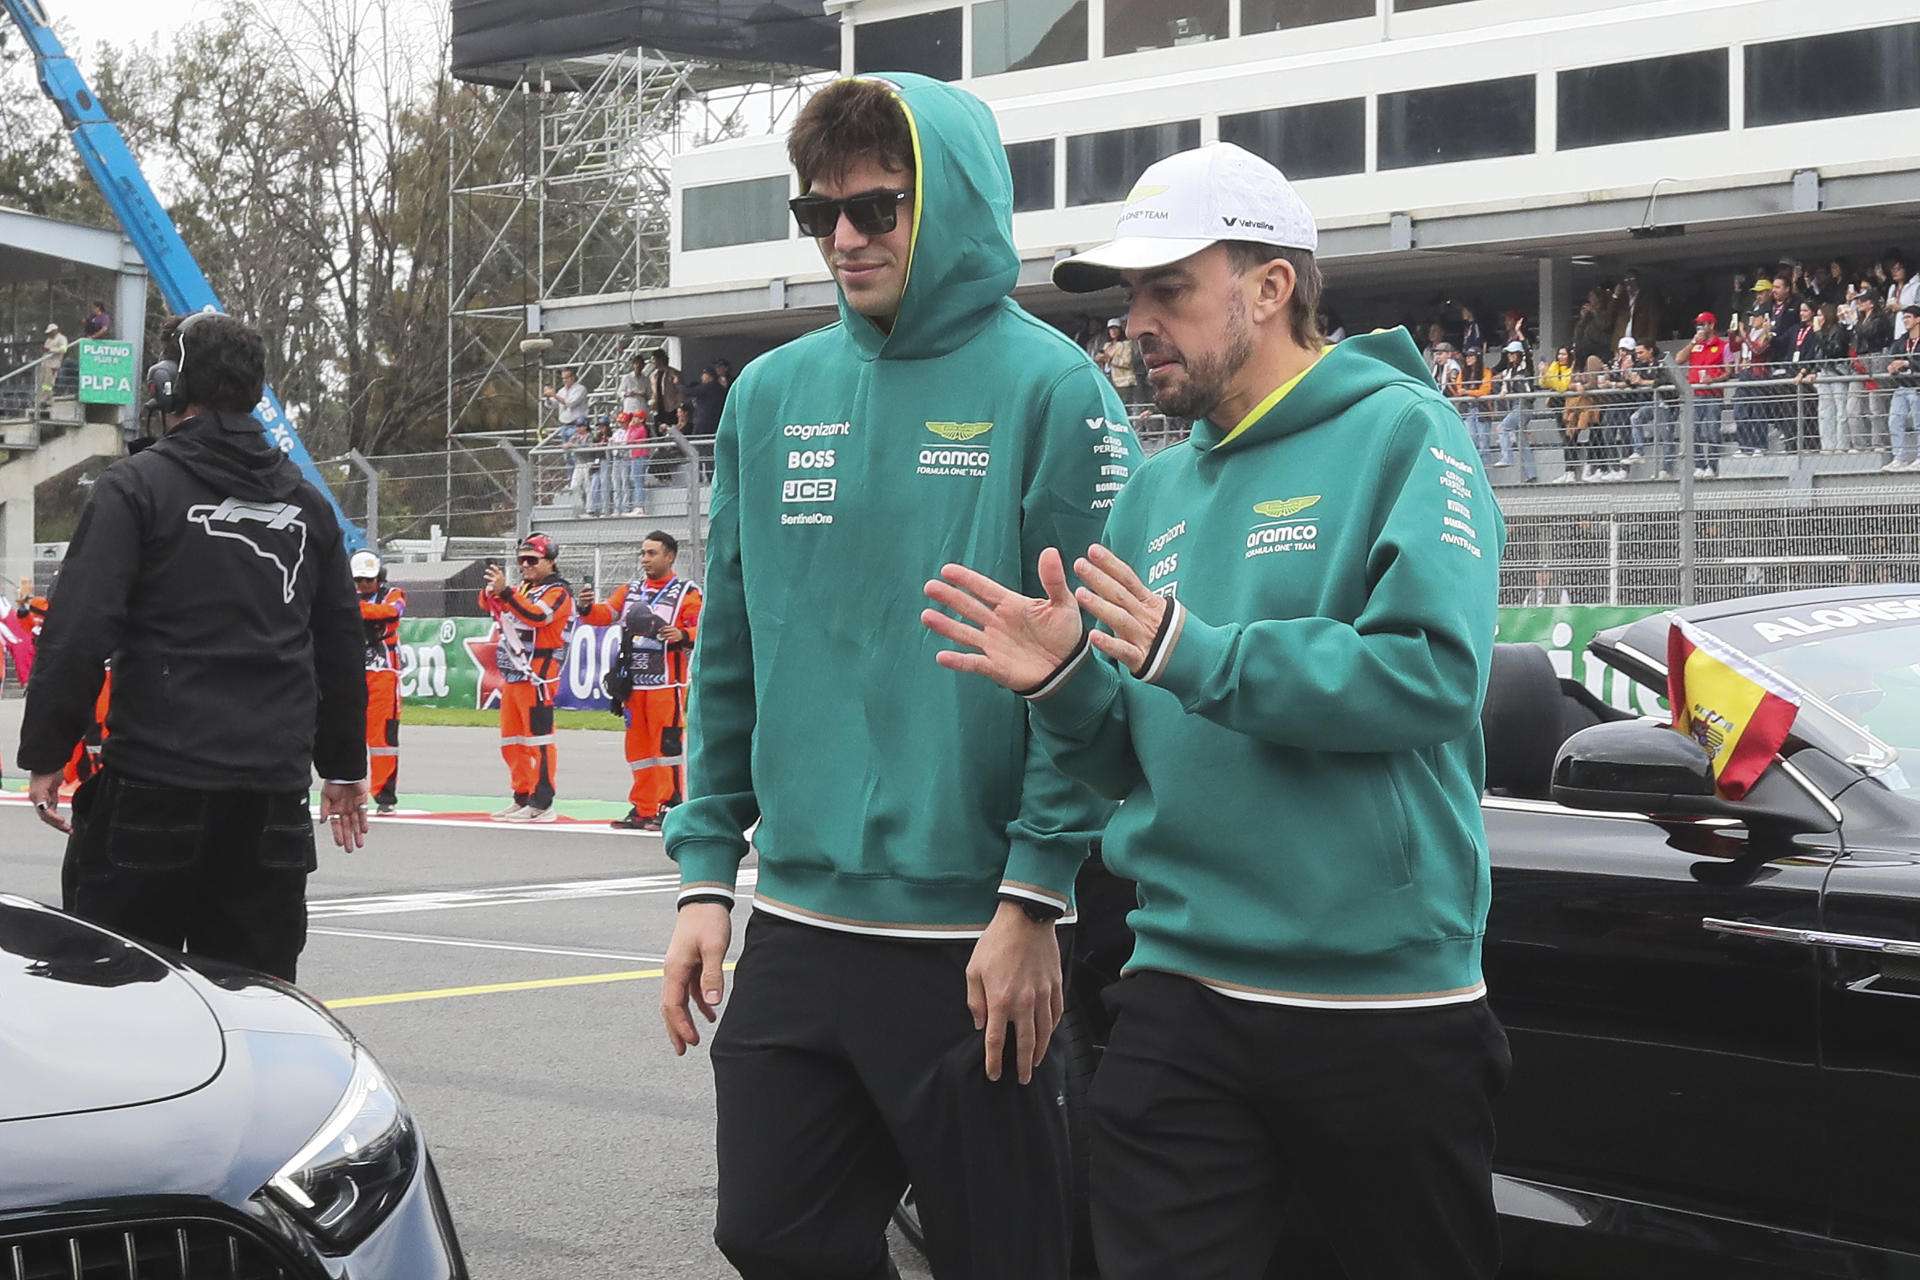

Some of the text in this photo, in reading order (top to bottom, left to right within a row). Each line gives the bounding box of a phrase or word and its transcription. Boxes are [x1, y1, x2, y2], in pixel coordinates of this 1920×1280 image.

[1144, 210, 1168, 220] TEAM
[1238, 219, 1274, 231] Valvoline
[83, 344, 130, 357] PLATINO
[80, 375, 131, 392] PLP A
[783, 421, 851, 441] cognizant
[787, 449, 836, 469] BOSS
[919, 450, 990, 467] aramco
[916, 466, 950, 476] FORMULA
[969, 469, 988, 477] TEAM
[784, 481, 834, 499] JCB
[780, 512, 834, 525] SentinelOne
[1147, 519, 1186, 554] cognizant
[1246, 525, 1318, 548] aramco
[1294, 542, 1317, 551] TEAM
[1148, 553, 1178, 585] BOSS
